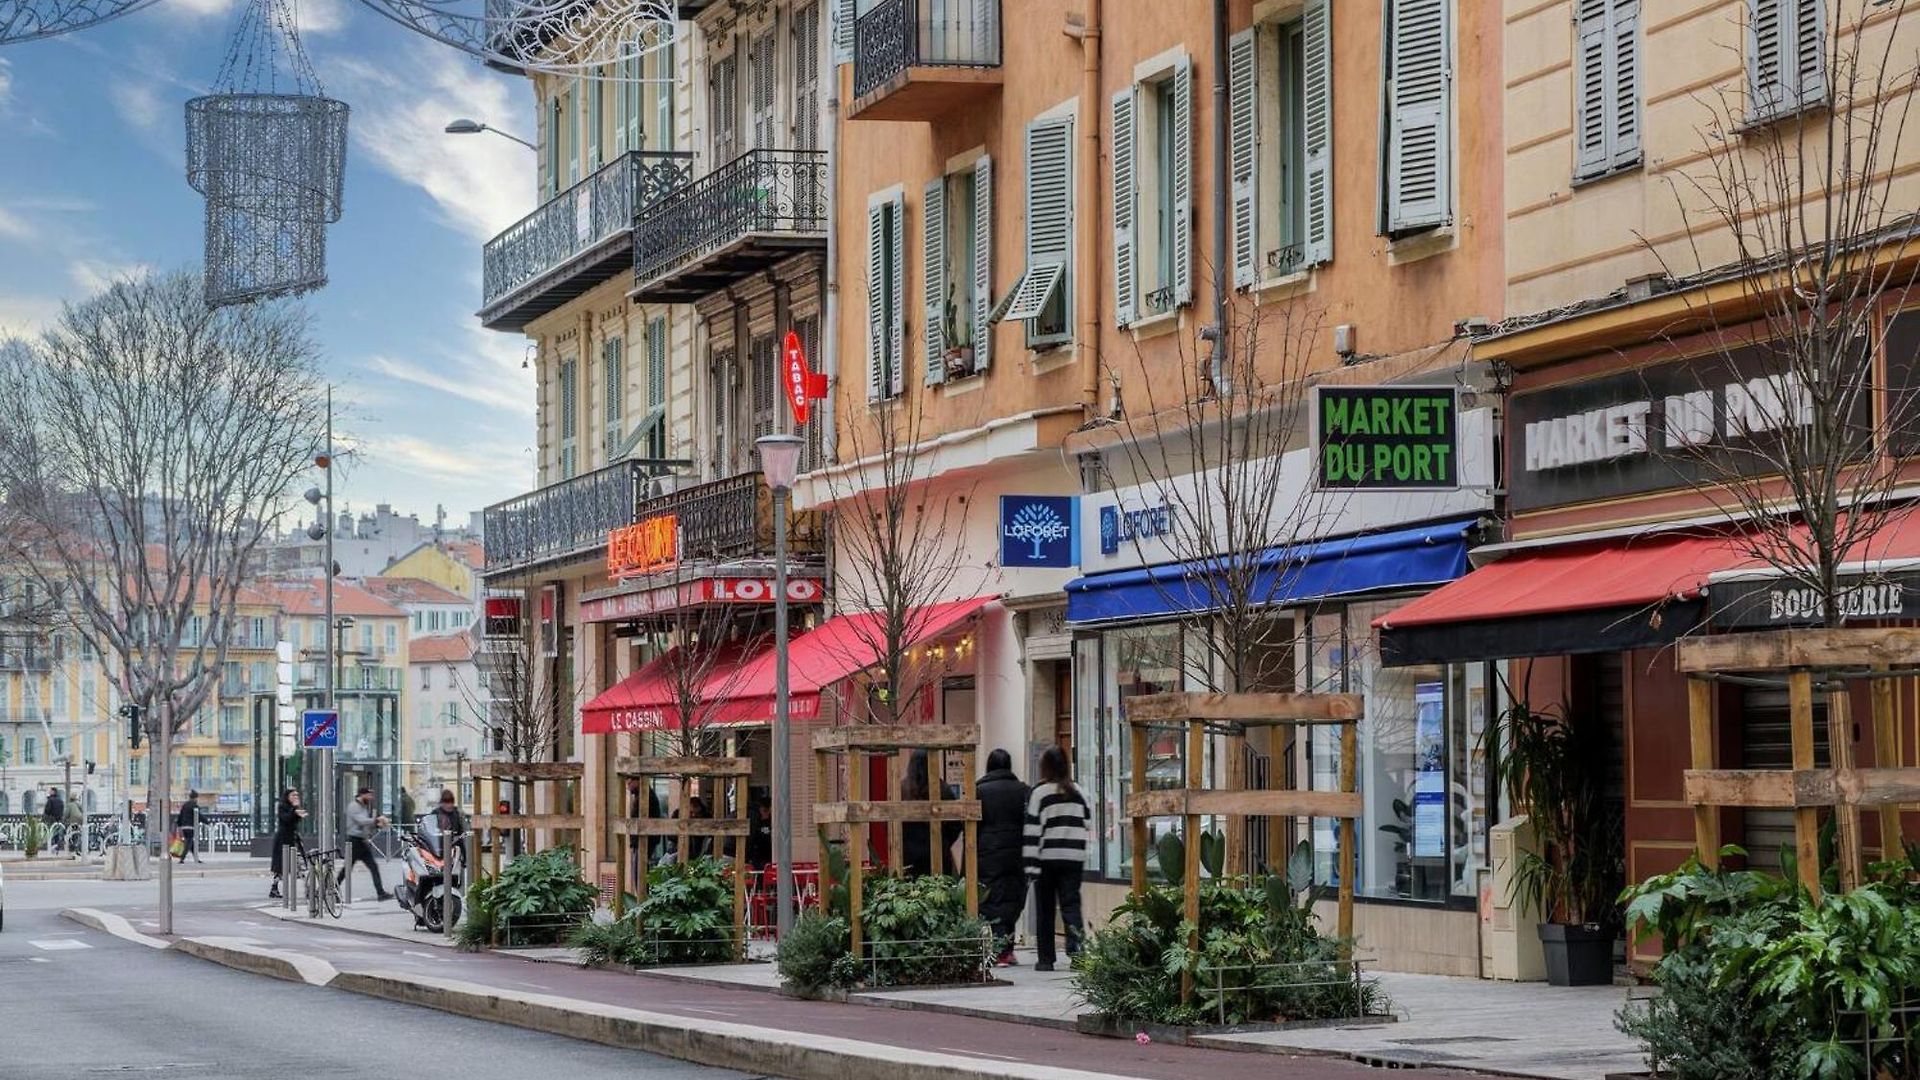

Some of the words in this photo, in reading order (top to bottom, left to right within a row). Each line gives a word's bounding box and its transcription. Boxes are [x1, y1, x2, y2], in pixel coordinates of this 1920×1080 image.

[789, 349, 805, 407] TABAC
[1325, 397, 1450, 435] MARKET
[1525, 400, 1651, 471] MARKET
[1665, 390, 1714, 448] DU
[1325, 443, 1366, 481] DU
[1374, 443, 1450, 481] PORT
[611, 712, 622, 729] LE
[625, 710, 663, 729] CASSINI
